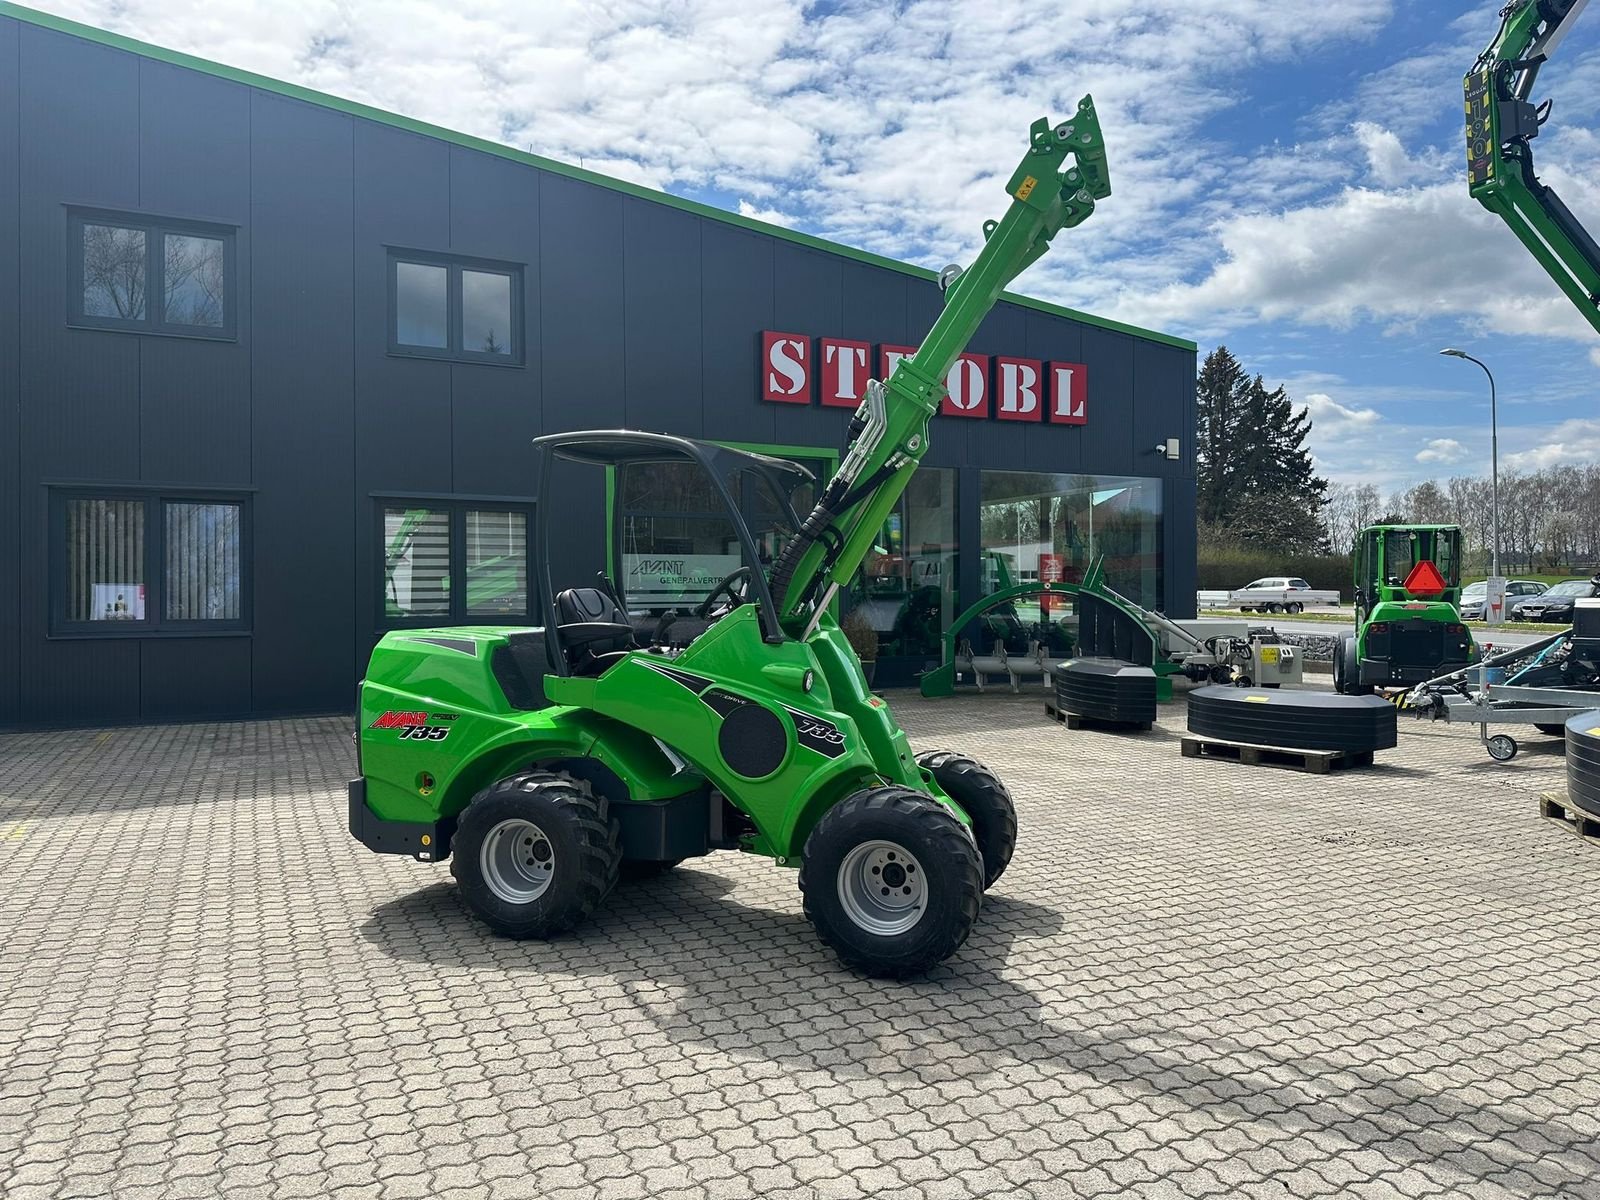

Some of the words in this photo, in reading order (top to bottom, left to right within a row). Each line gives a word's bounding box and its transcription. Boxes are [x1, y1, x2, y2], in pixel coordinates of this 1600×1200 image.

[769, 338, 1084, 417] STOBL
[630, 560, 685, 575] AVANT
[659, 576, 725, 585] GENERALVERTR
[368, 710, 429, 729] AVANT
[397, 725, 451, 742] 735
[797, 719, 847, 744] 735
